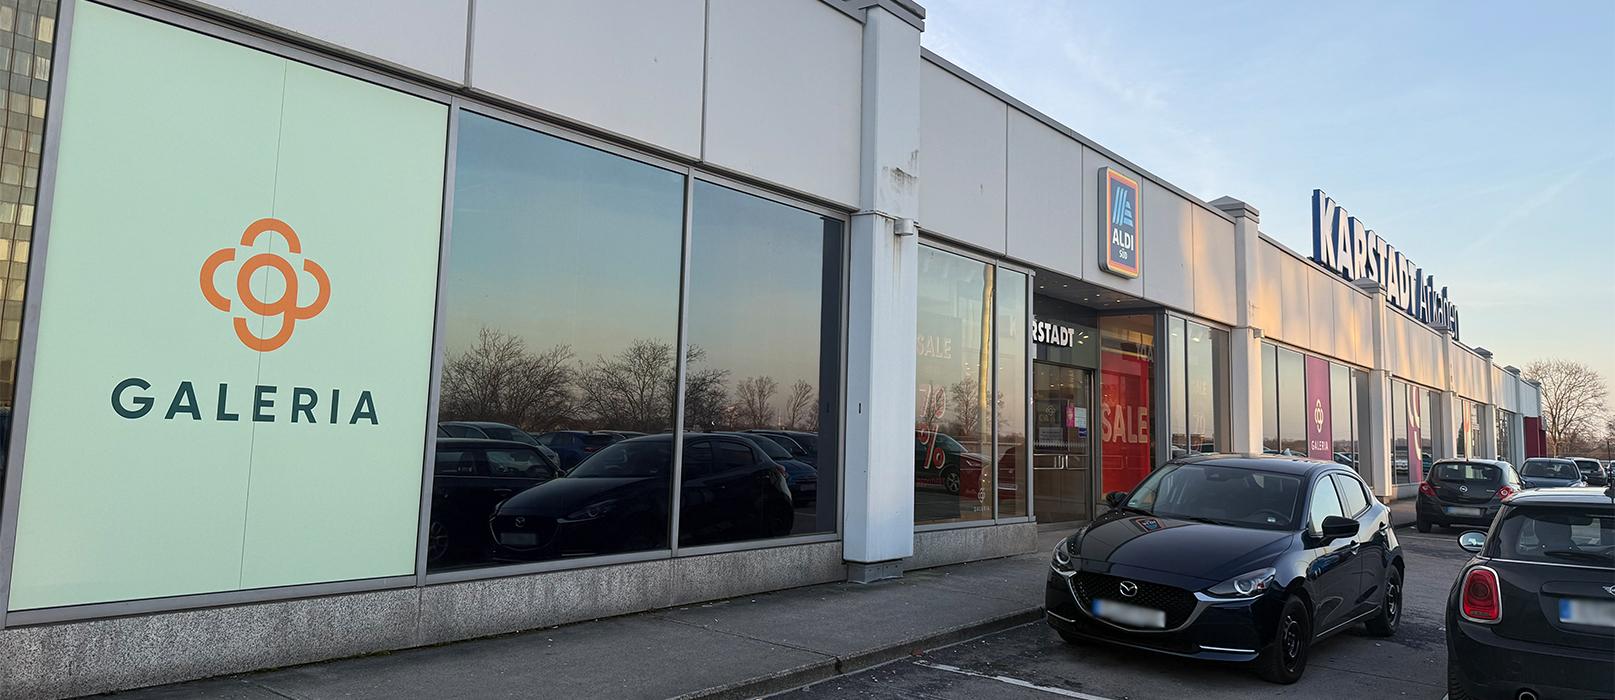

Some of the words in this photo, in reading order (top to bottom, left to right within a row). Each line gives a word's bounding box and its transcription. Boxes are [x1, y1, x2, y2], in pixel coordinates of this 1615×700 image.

[1112, 228, 1134, 251] ALDI
[1312, 189, 1416, 316] KARSTADT
[918, 336, 951, 359] SALE
[111, 377, 379, 425] GALERIA
[919, 384, 946, 419] 70
[1102, 403, 1147, 443] SALE
[1311, 440, 1328, 451] GALERIA
